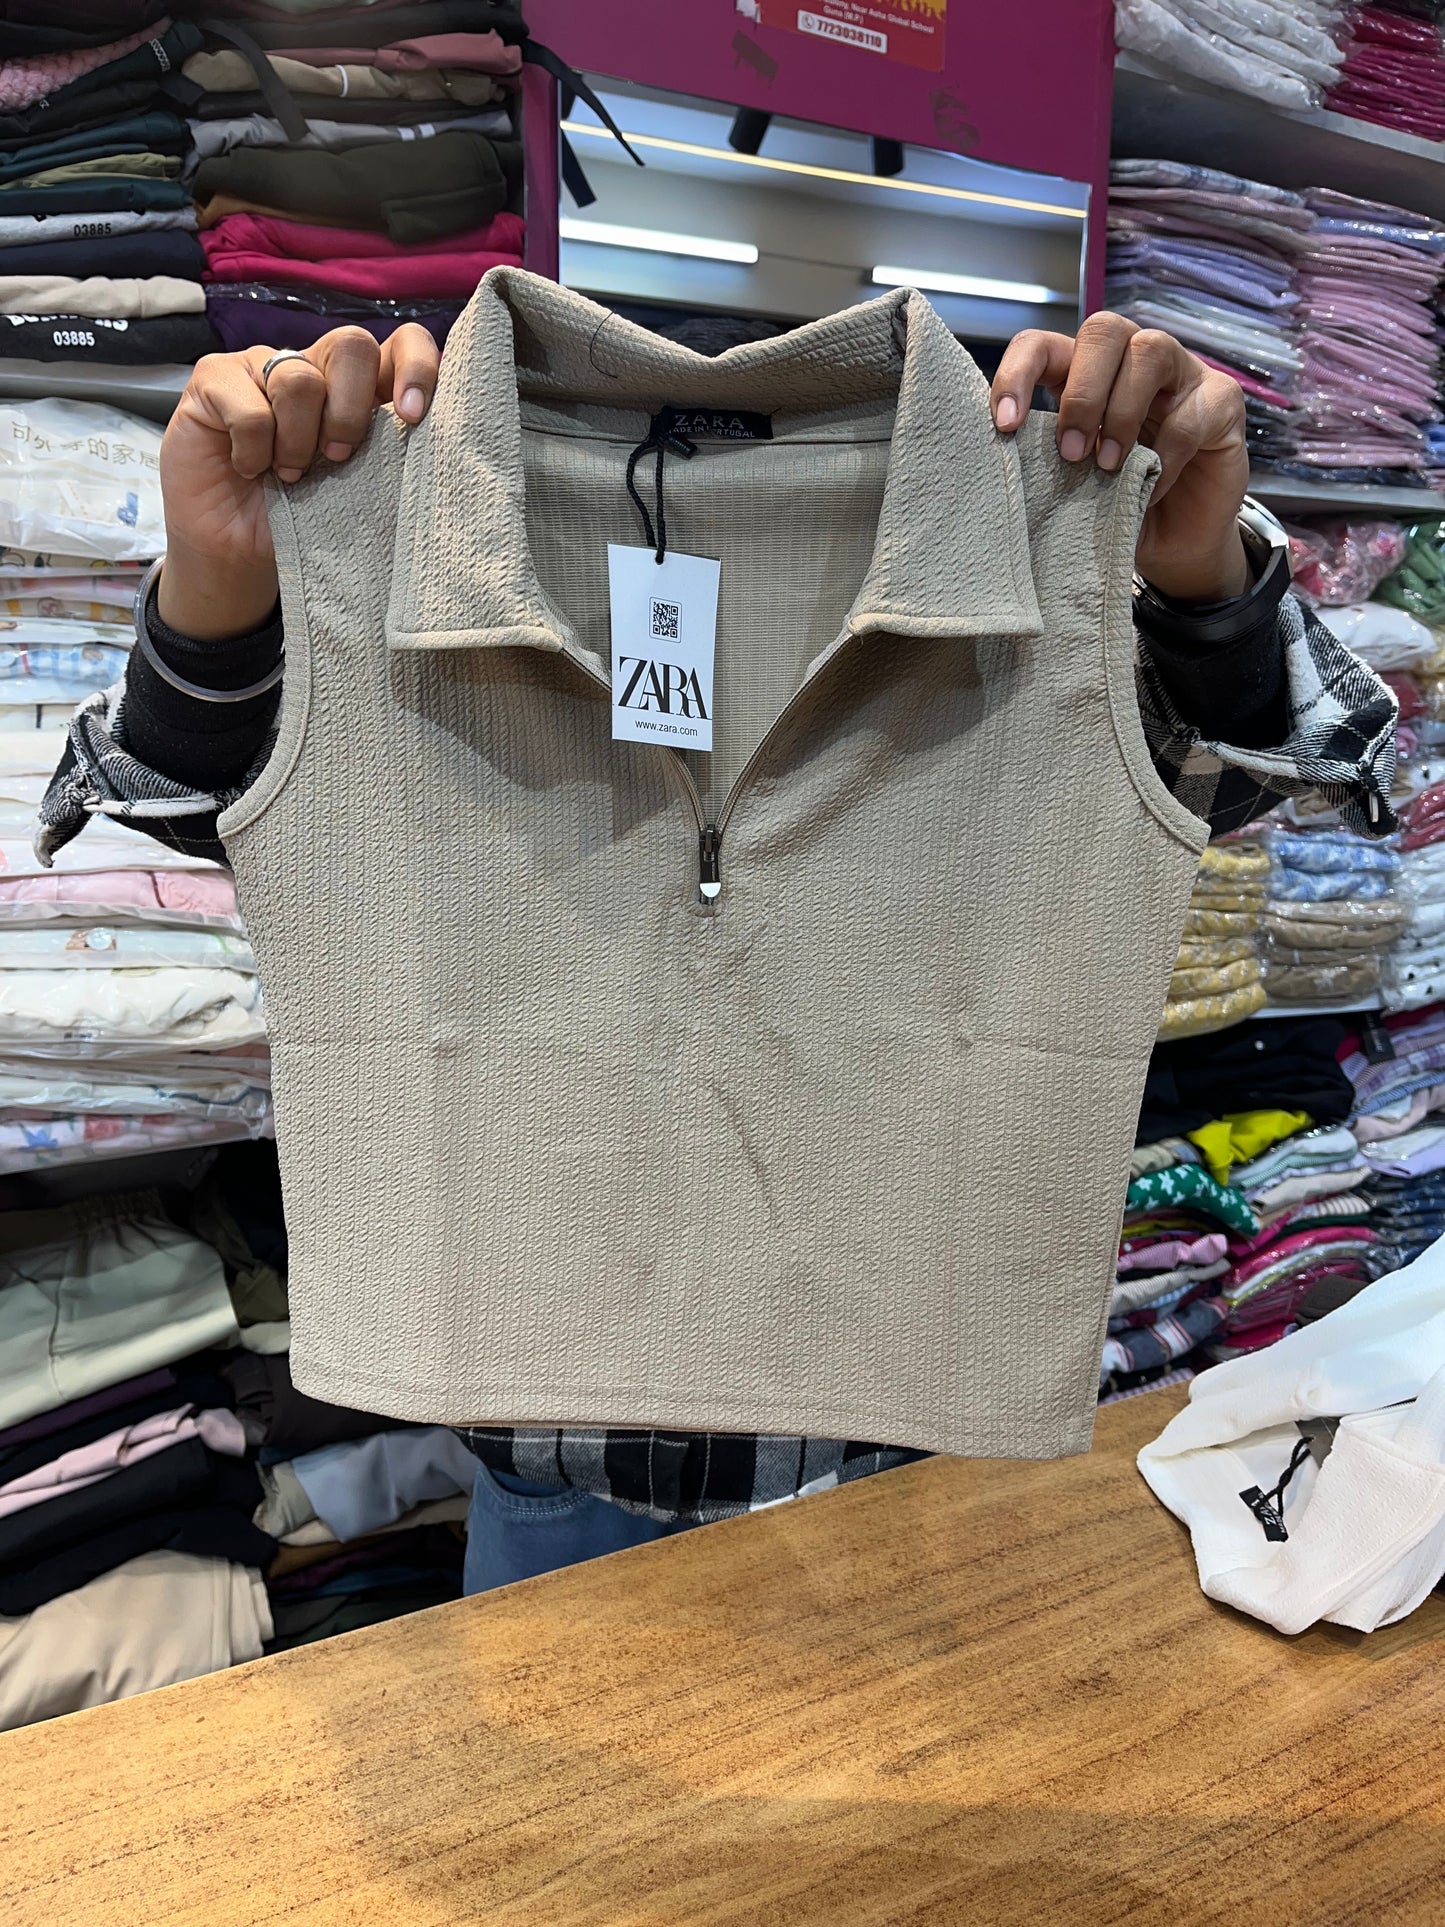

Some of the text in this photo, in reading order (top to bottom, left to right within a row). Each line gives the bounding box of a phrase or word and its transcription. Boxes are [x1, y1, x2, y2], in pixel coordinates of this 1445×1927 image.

[823, 5, 843, 18] Guna
[851, 2, 868, 14] Near
[886, 13, 910, 27] Global
[910, 19, 935, 34] School
[816, 19, 882, 48] 7723038110
[74, 223, 112, 238] 03885
[53, 331, 95, 346] 03885
[675, 414, 745, 430] ZARA
[617, 656, 713, 721] ZARA
[634, 719, 699, 737] www.zara.com
